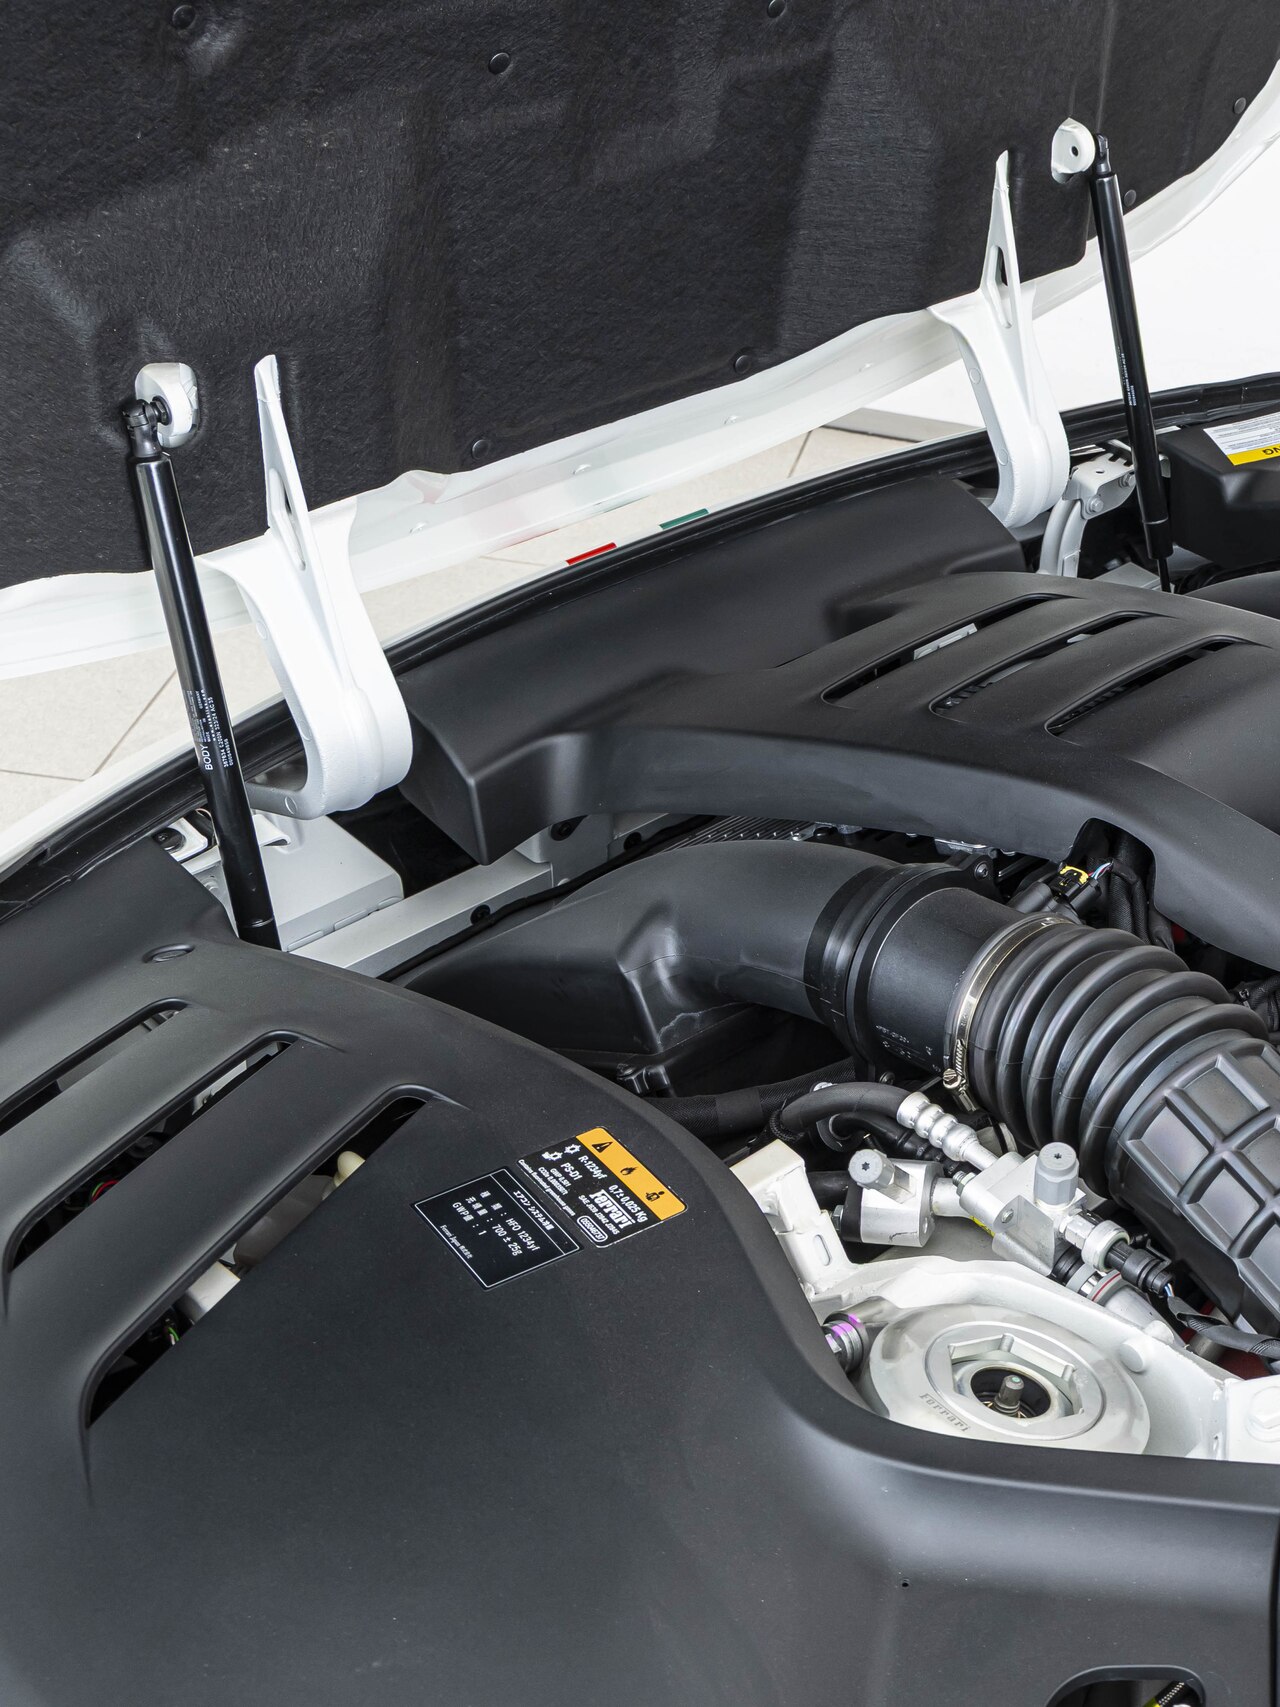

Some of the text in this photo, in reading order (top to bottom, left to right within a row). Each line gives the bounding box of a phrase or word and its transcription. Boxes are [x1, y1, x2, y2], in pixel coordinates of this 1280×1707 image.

[199, 744, 213, 770] BODY
[560, 1162, 583, 1180] PS-D1
[578, 1155, 607, 1179] R-1234yf
[589, 1189, 636, 1229] Ferrari
[492, 1224, 507, 1236] 700
[508, 1242, 522, 1256] 25g
[505, 1218, 521, 1231] HFO
[517, 1230, 540, 1251] 1234yf
[919, 1393, 971, 1432] Ferrari
